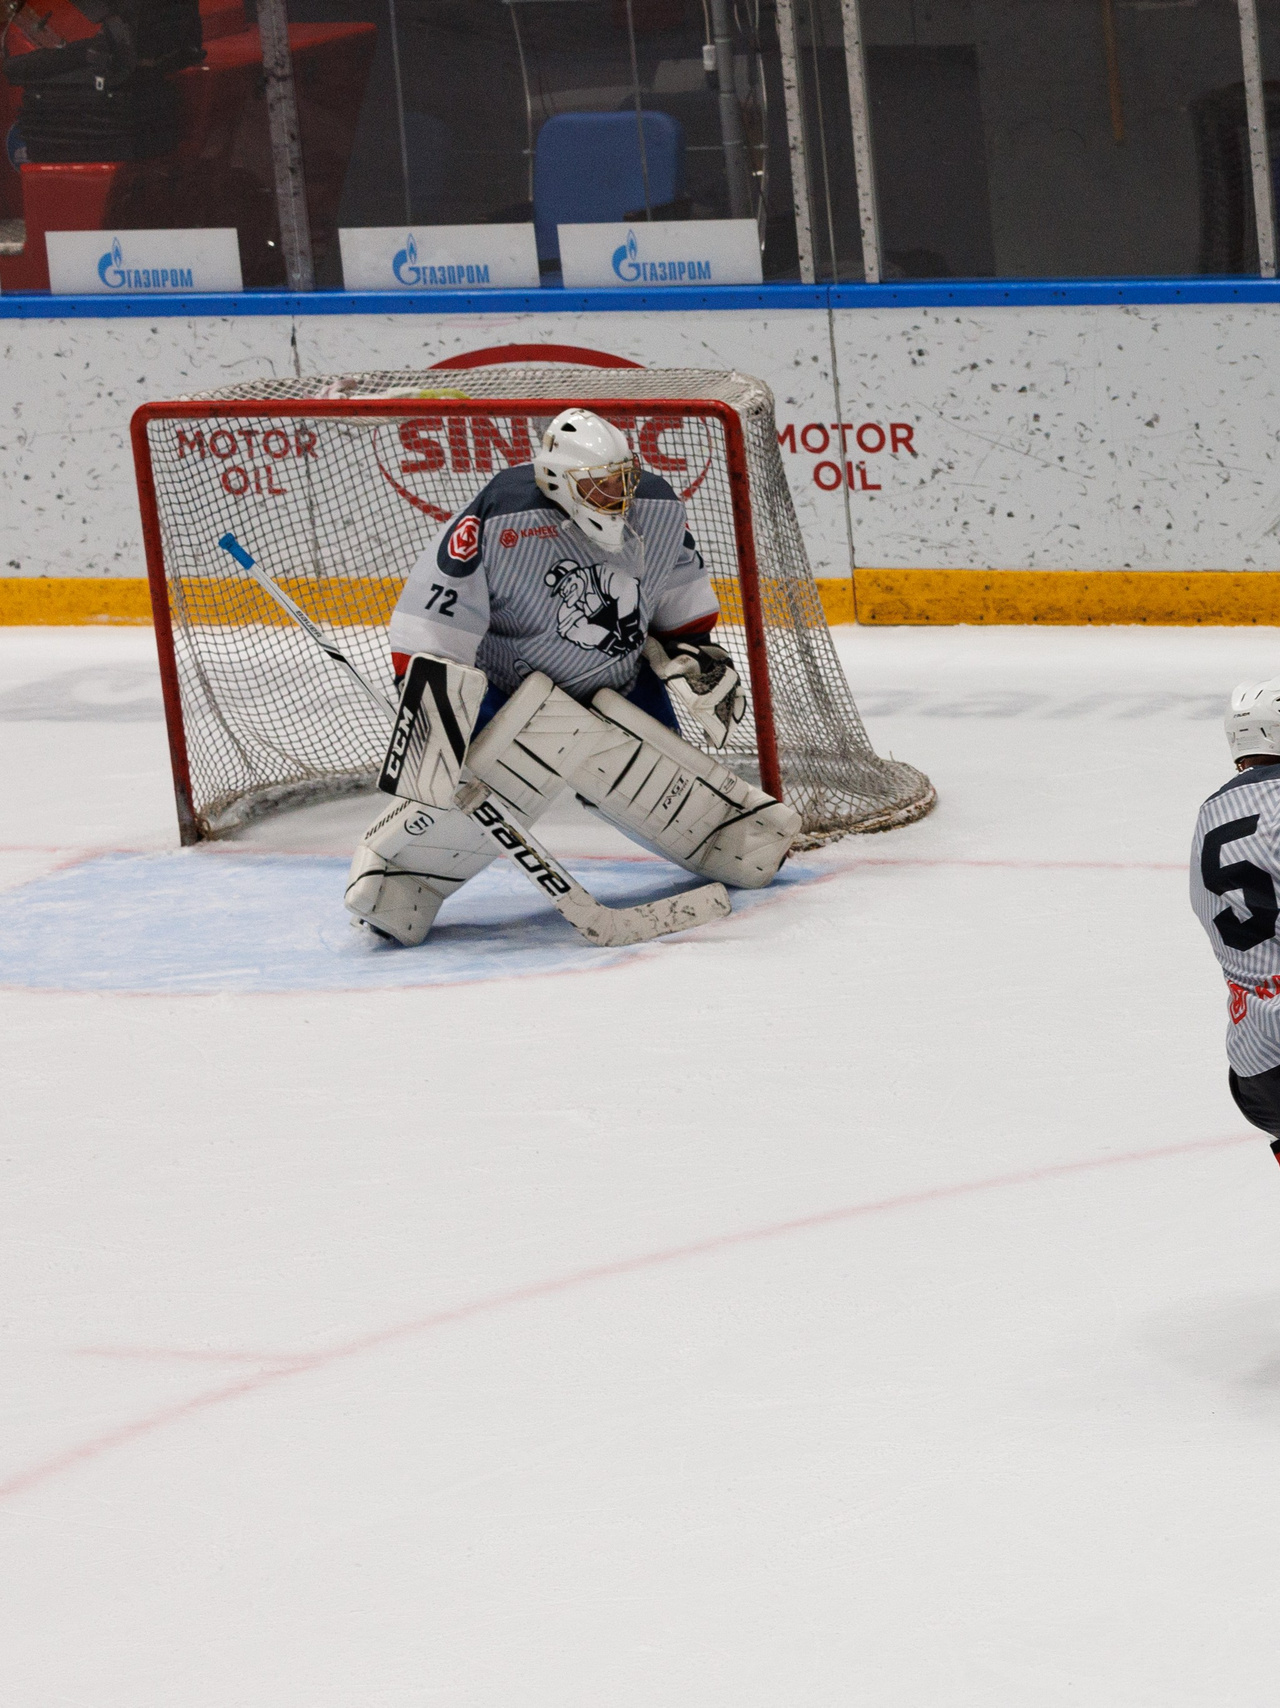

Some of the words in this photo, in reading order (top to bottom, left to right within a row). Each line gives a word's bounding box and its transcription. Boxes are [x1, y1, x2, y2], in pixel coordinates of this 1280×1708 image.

[126, 268, 194, 288] ГАЗПРОМ
[421, 264, 491, 284] ГАЗПРОМ
[641, 260, 712, 281] ГАЗПРОМ
[177, 429, 318, 459] MOTOR
[400, 416, 688, 473] SINC
[777, 423, 918, 454] MOTOR
[221, 465, 287, 495] OIL
[813, 461, 882, 491] OIL
[424, 584, 459, 617] 72
[386, 705, 414, 779] CCM
[1201, 813, 1280, 951] 5
